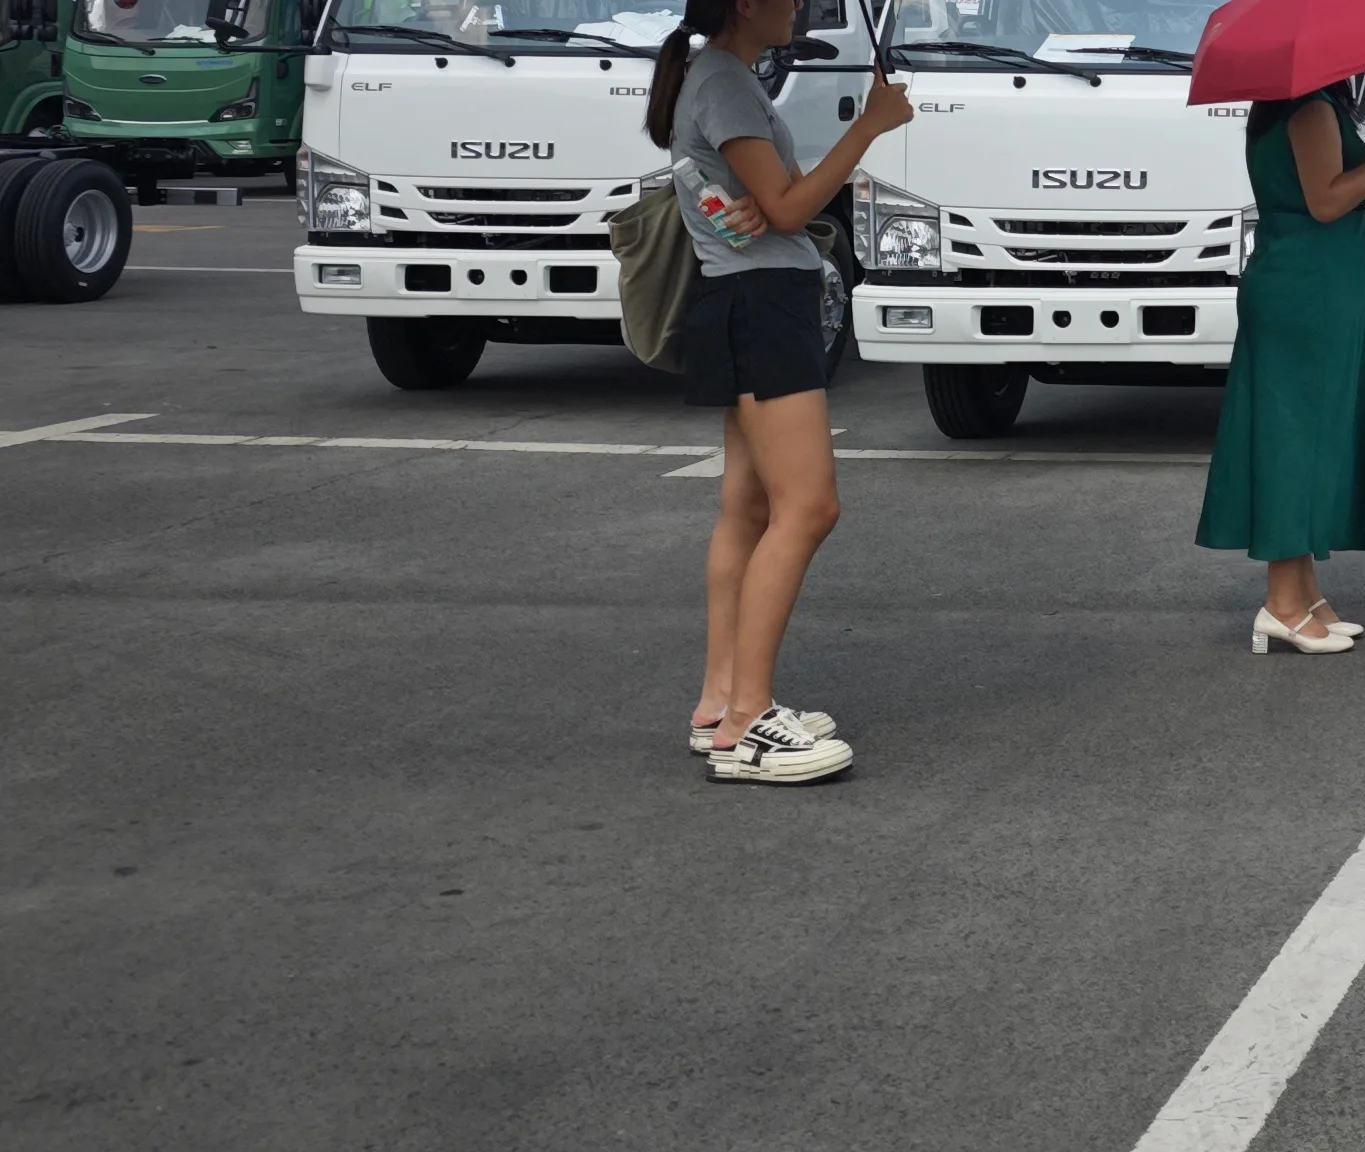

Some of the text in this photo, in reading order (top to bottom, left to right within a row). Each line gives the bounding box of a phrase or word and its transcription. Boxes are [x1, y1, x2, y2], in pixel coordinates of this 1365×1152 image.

[350, 82, 393, 92] ELF
[918, 102, 966, 113] ELF
[450, 139, 556, 160] ISUZU
[1031, 168, 1149, 190] ISUZU
